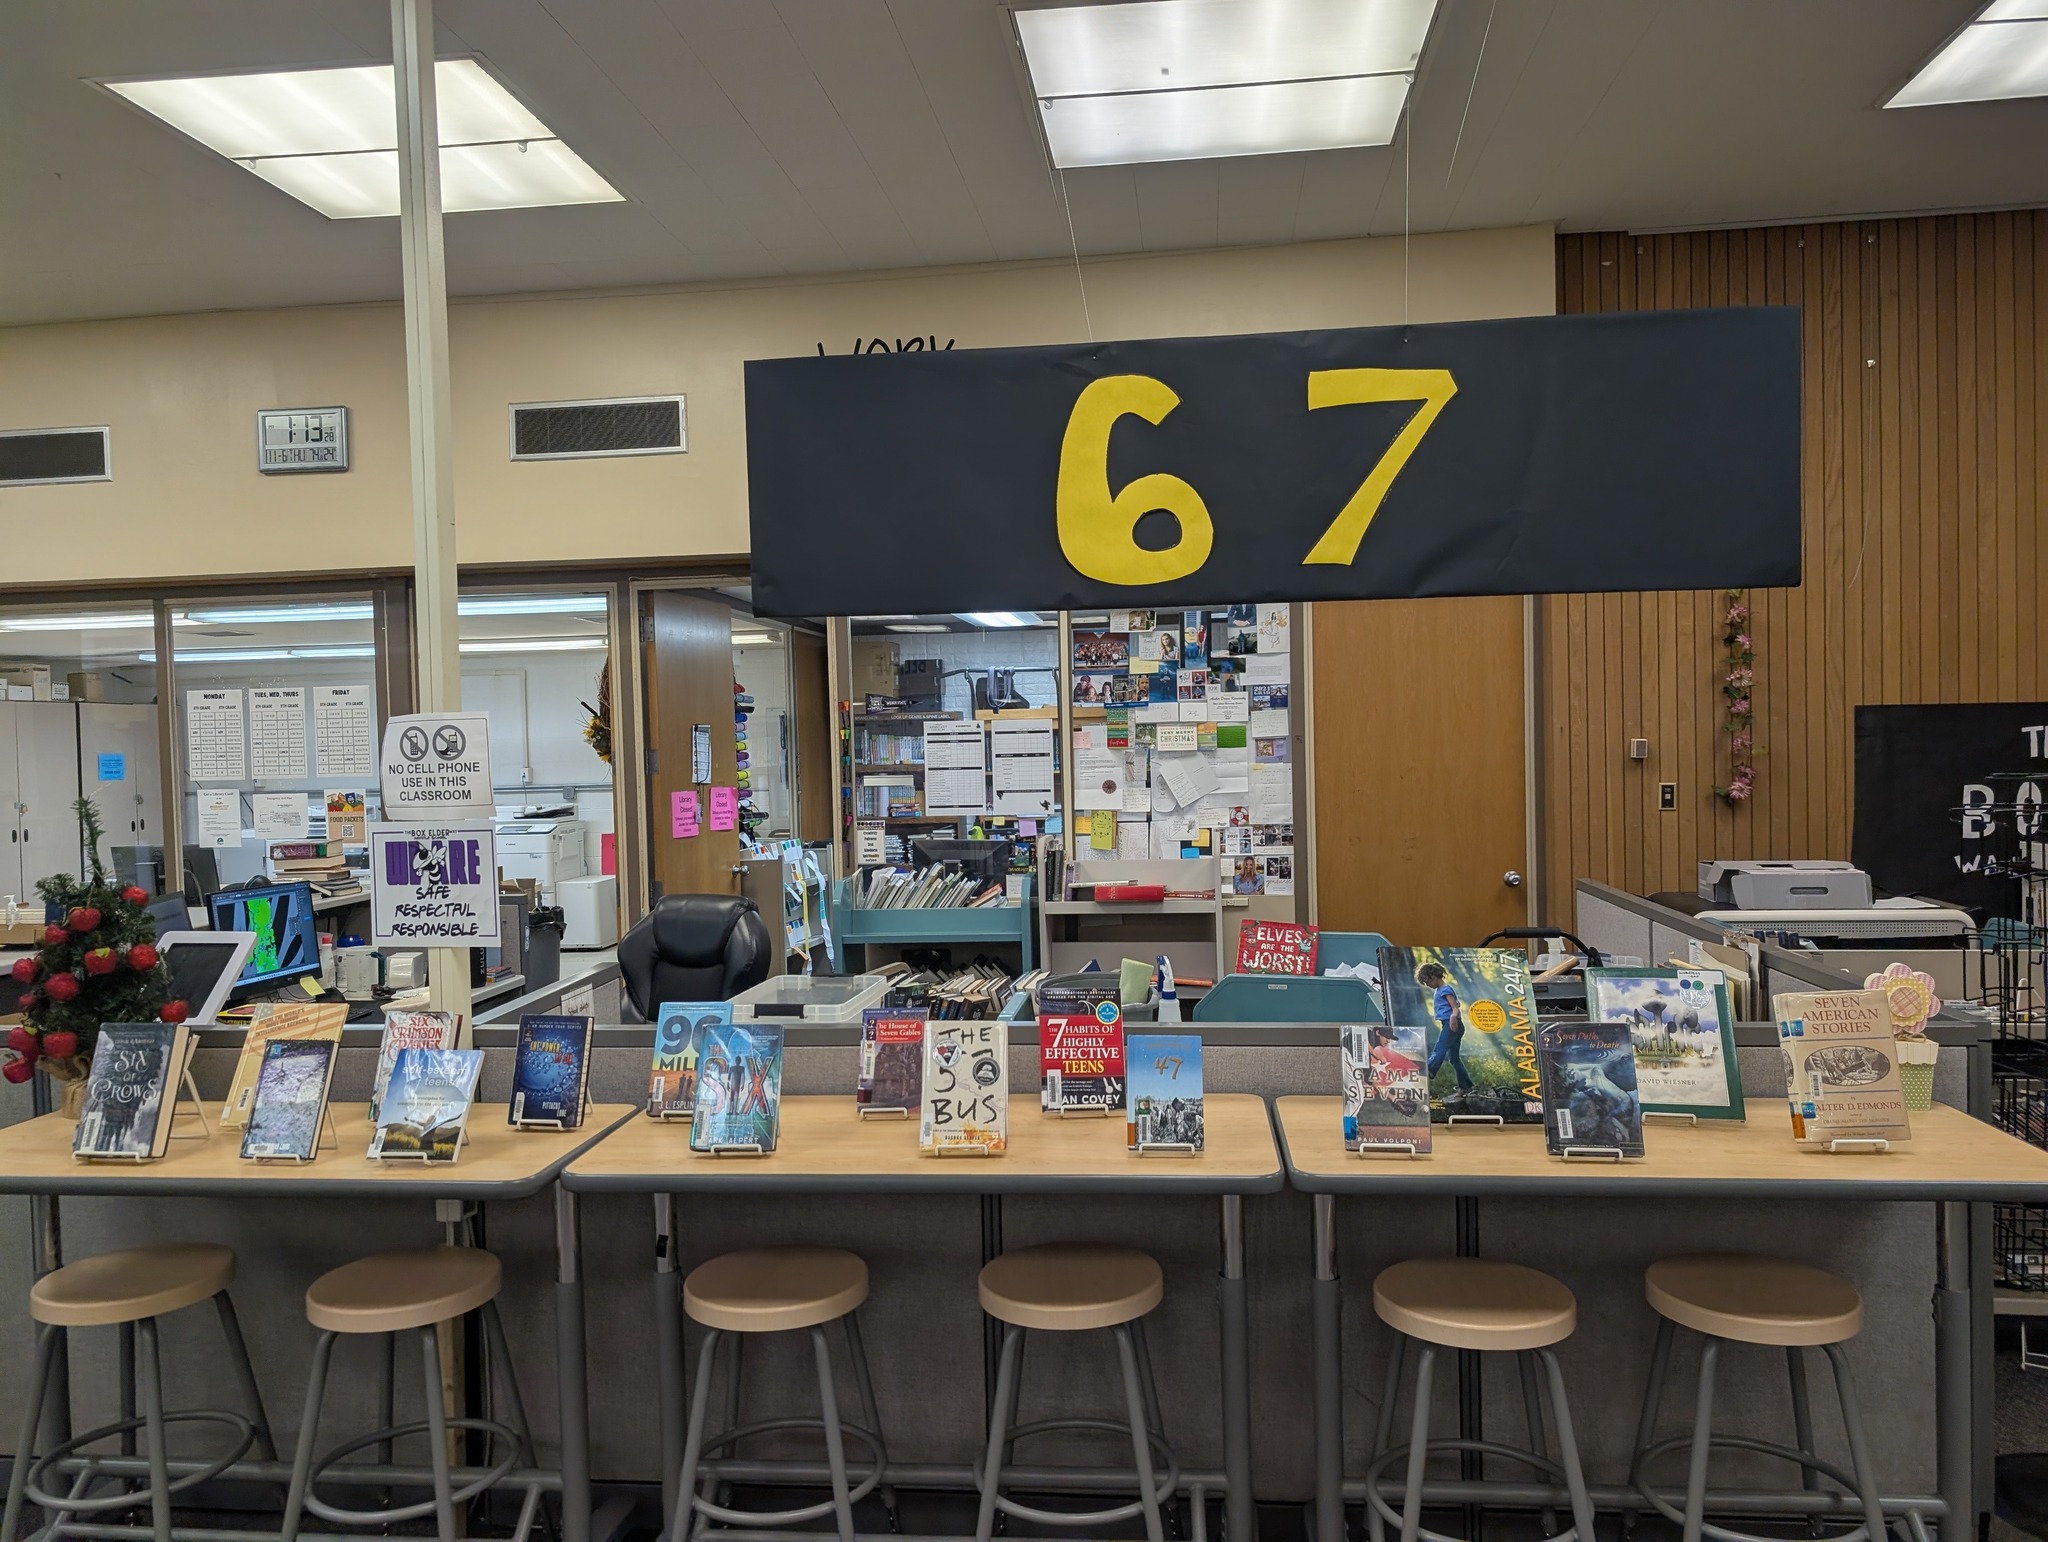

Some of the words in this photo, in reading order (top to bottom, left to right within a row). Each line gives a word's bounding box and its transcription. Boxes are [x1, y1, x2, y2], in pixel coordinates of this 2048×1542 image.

[288, 415, 323, 443] 1:13
[324, 431, 335, 442] 28
[1057, 374, 1214, 586] 6
[1302, 368, 1459, 566] 7
[1160, 734, 1195, 742] CHRISTMAS
[2021, 725, 2048, 759] T
[388, 764, 404, 775] NO
[407, 763, 435, 774] CELL
[438, 762, 480, 773] PHONE
[401, 777, 423, 788] USE
[425, 777, 436, 787] IN
[439, 776, 467, 787] THIS
[399, 790, 472, 801] CLASSROOM
[678, 796, 692, 804] Library
[411, 829, 426, 837] BOX
[428, 829, 450, 837] ELDER
[415, 885, 451, 900] SAFE
[395, 903, 476, 918] RESPECTFUL
[391, 922, 480, 938] RESPONSIBLE
[1256, 926, 1302, 944] ELVES
[1260, 943, 1275, 951] ARE
[1280, 944, 1295, 953] THE
[1242, 950, 1311, 974] WORST!
[1500, 953, 1526, 996] 24/7
[1814, 996, 1861, 1009] SEVEN
[409, 1016, 430, 1027] SIX
[1801, 1008, 1879, 1022] AMERICAN
[909, 1021, 918, 1029] of
[1812, 1021, 1872, 1034] STORIES
[392, 1027, 443, 1039] CRIMSON
[938, 1026, 992, 1045] THE
[1047, 1018, 1068, 1048] 7
[1065, 1025, 1100, 1034] HABITS
[1101, 1025, 1115, 1034] OF
[1555, 1030, 1577, 1044] Seven
[1062, 1037, 1105, 1047] HIGHLY
[1507, 996, 1542, 1099] ALABAMA
[1597, 1040, 1620, 1049] Death
[1045, 1047, 1120, 1060] EFFECTIVE
[114, 1048, 150, 1073] SIX
[1062, 1060, 1105, 1074] TEENS
[402, 1064, 468, 1075] self-esteem
[1154, 1055, 1184, 1080] 47
[122, 1072, 137, 1082] OF
[424, 1077, 454, 1086] teens
[1353, 1068, 1420, 1082] GAME
[91, 1079, 160, 1103] CROWS
[1348, 1085, 1425, 1101] SEVEN
[542, 1101, 561, 1109] PITTACUS
[665, 1101, 671, 1110] L.
[672, 1100, 694, 1110] ESPLIN
[1061, 1095, 1078, 1104] AN
[1081, 1094, 1120, 1104] COVEY
[930, 1094, 997, 1125] BUS
[1525, 1102, 1542, 1113] DK
[1815, 1103, 1845, 1111] ALTER
[1847, 1103, 1855, 1111] D.
[1857, 1101, 1902, 1110] EDMONDS
[556, 1109, 567, 1117] LORE
